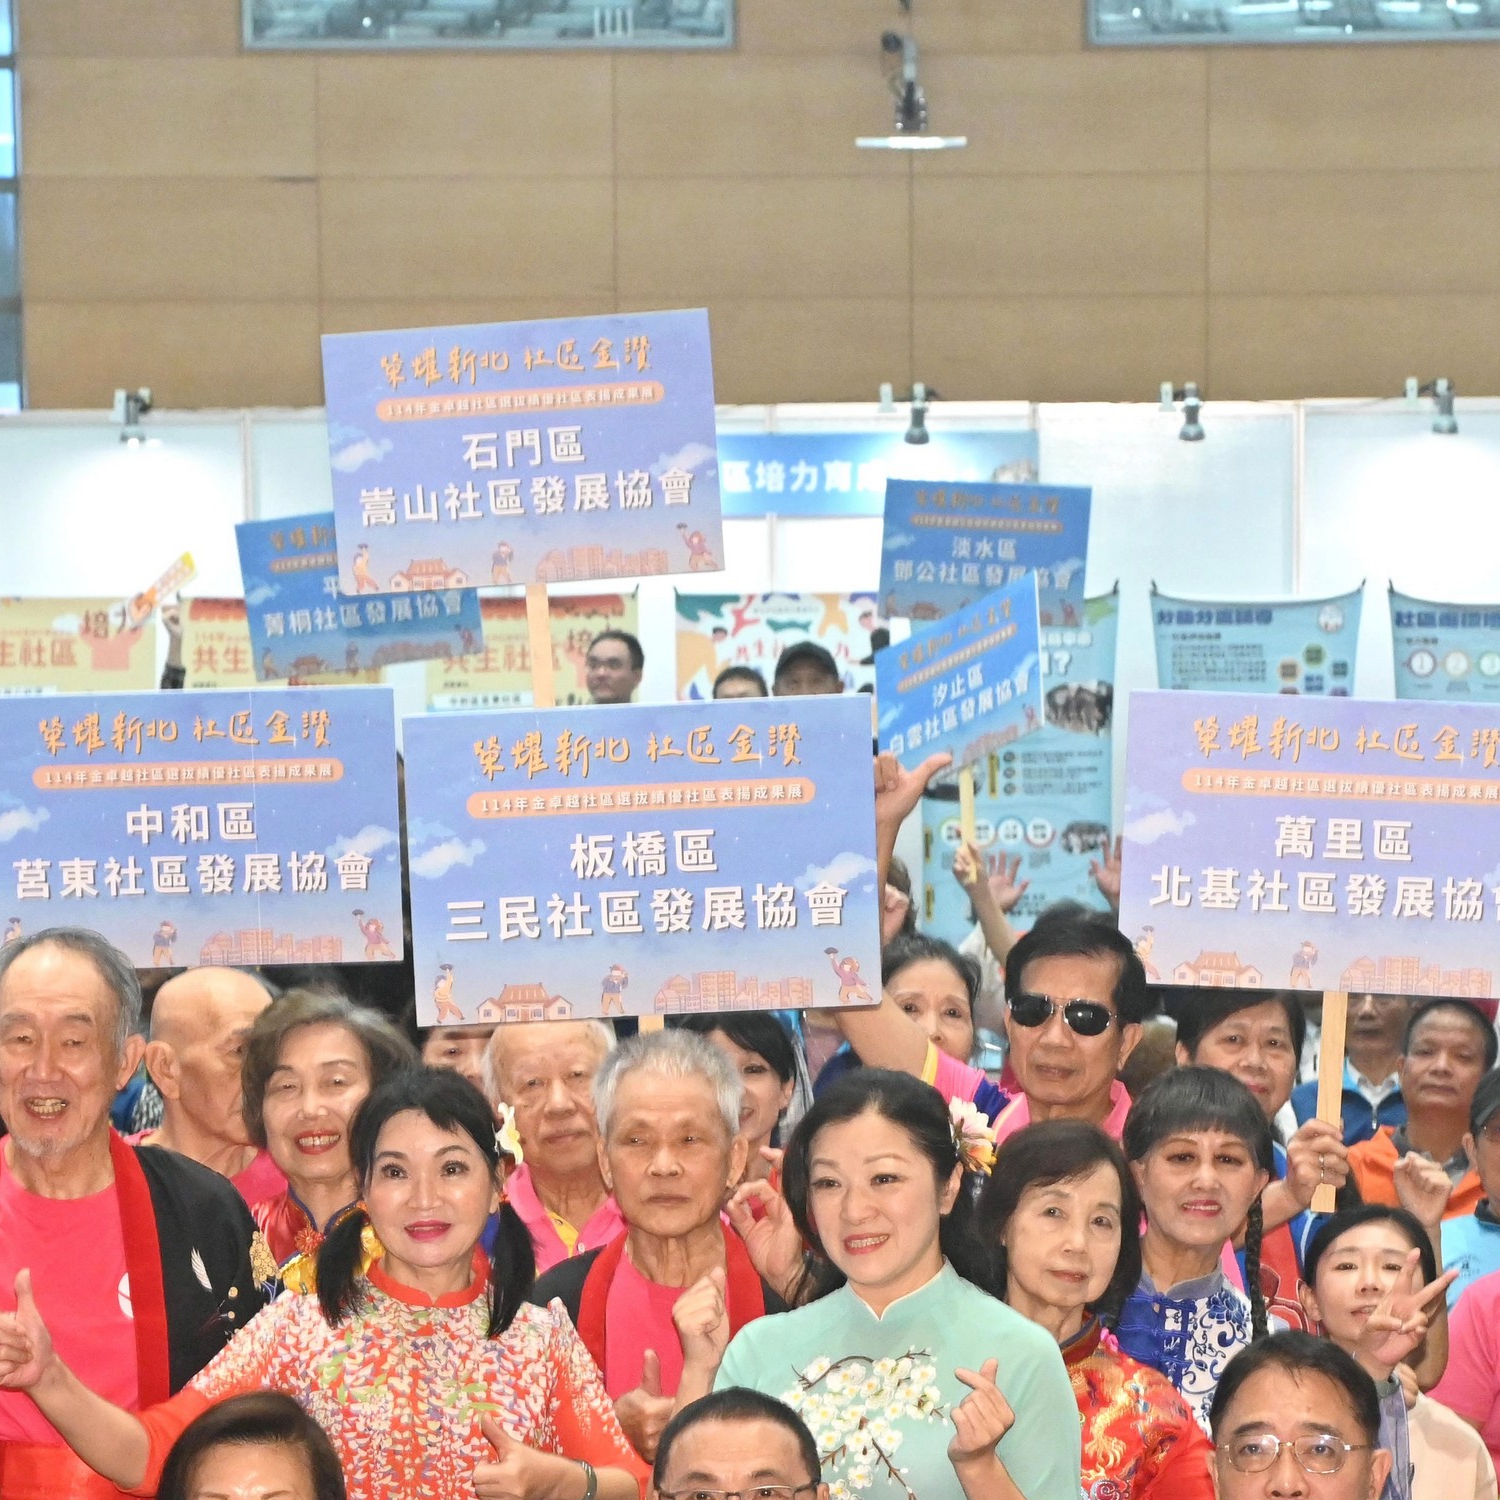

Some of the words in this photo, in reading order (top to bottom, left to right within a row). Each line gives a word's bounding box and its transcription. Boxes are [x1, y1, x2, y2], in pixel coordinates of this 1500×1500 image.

[381, 347, 510, 387] 榮耀新北
[524, 336, 651, 373] 社區金讚
[462, 426, 585, 471] 石門區
[359, 467, 695, 527] 嵩山社區發展協會
[952, 537, 1017, 561] 淡水區
[933, 663, 984, 707] 汐止區
[39, 714, 178, 756] 榮耀新北
[193, 710, 332, 747] 社區金讚
[473, 728, 630, 781] 榮耀新北
[647, 723, 802, 766] 社區金讚
[1193, 714, 1339, 760] 榮耀新北
[125, 801, 257, 845] 中和區
[1274, 815, 1413, 863] 萬里區
[12, 850, 373, 900] 莒東社區發展協會
[570, 829, 718, 879] 板橋區
[445, 880, 848, 942] 三民社區發展協會
